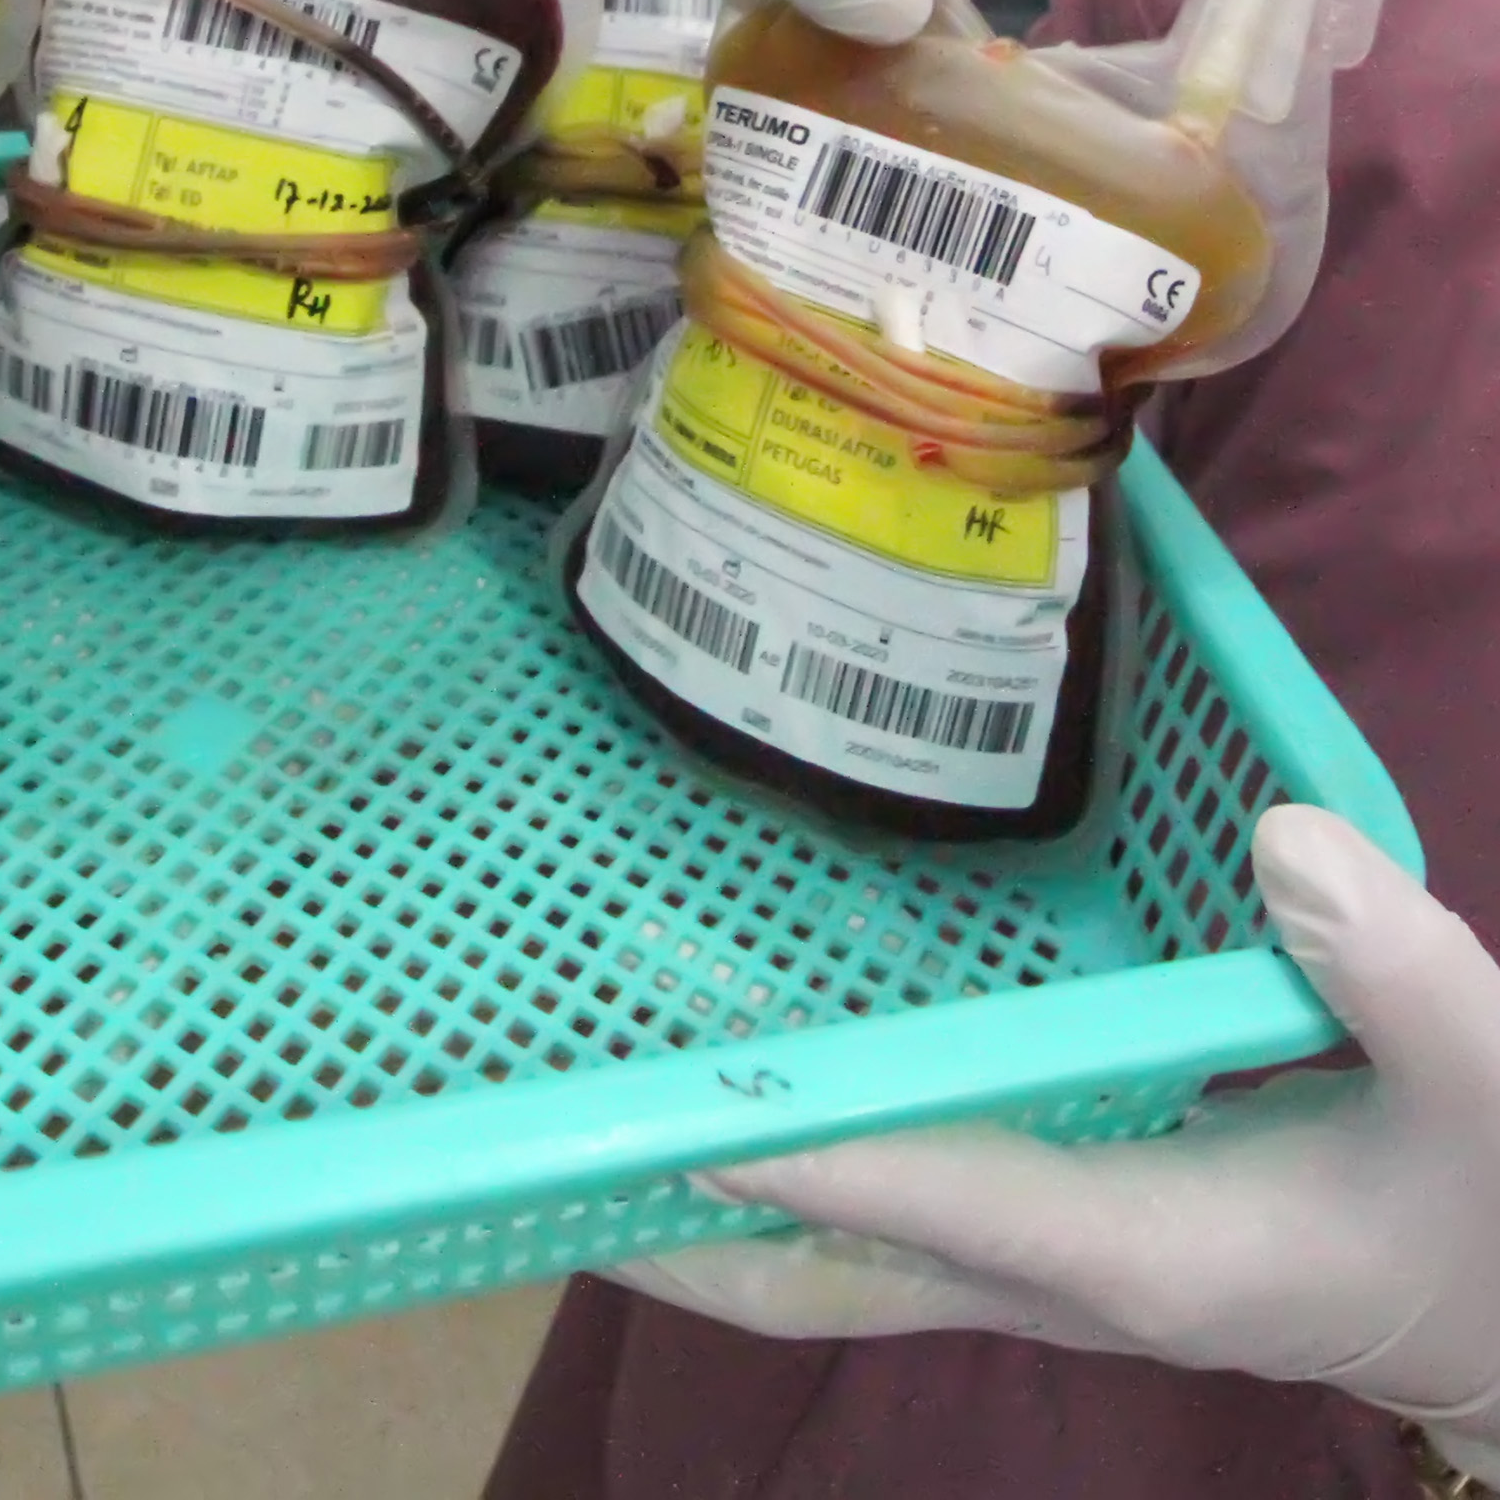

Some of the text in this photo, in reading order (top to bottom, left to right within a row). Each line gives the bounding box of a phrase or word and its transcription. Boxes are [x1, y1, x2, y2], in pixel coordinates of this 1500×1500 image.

[715, 100, 811, 146] TERUMO
[1147, 268, 1186, 310] CE
[761, 437, 843, 485] PETUGAS
[770, 407, 840, 447] DURASI
[840, 437, 898, 470] AFTAP
